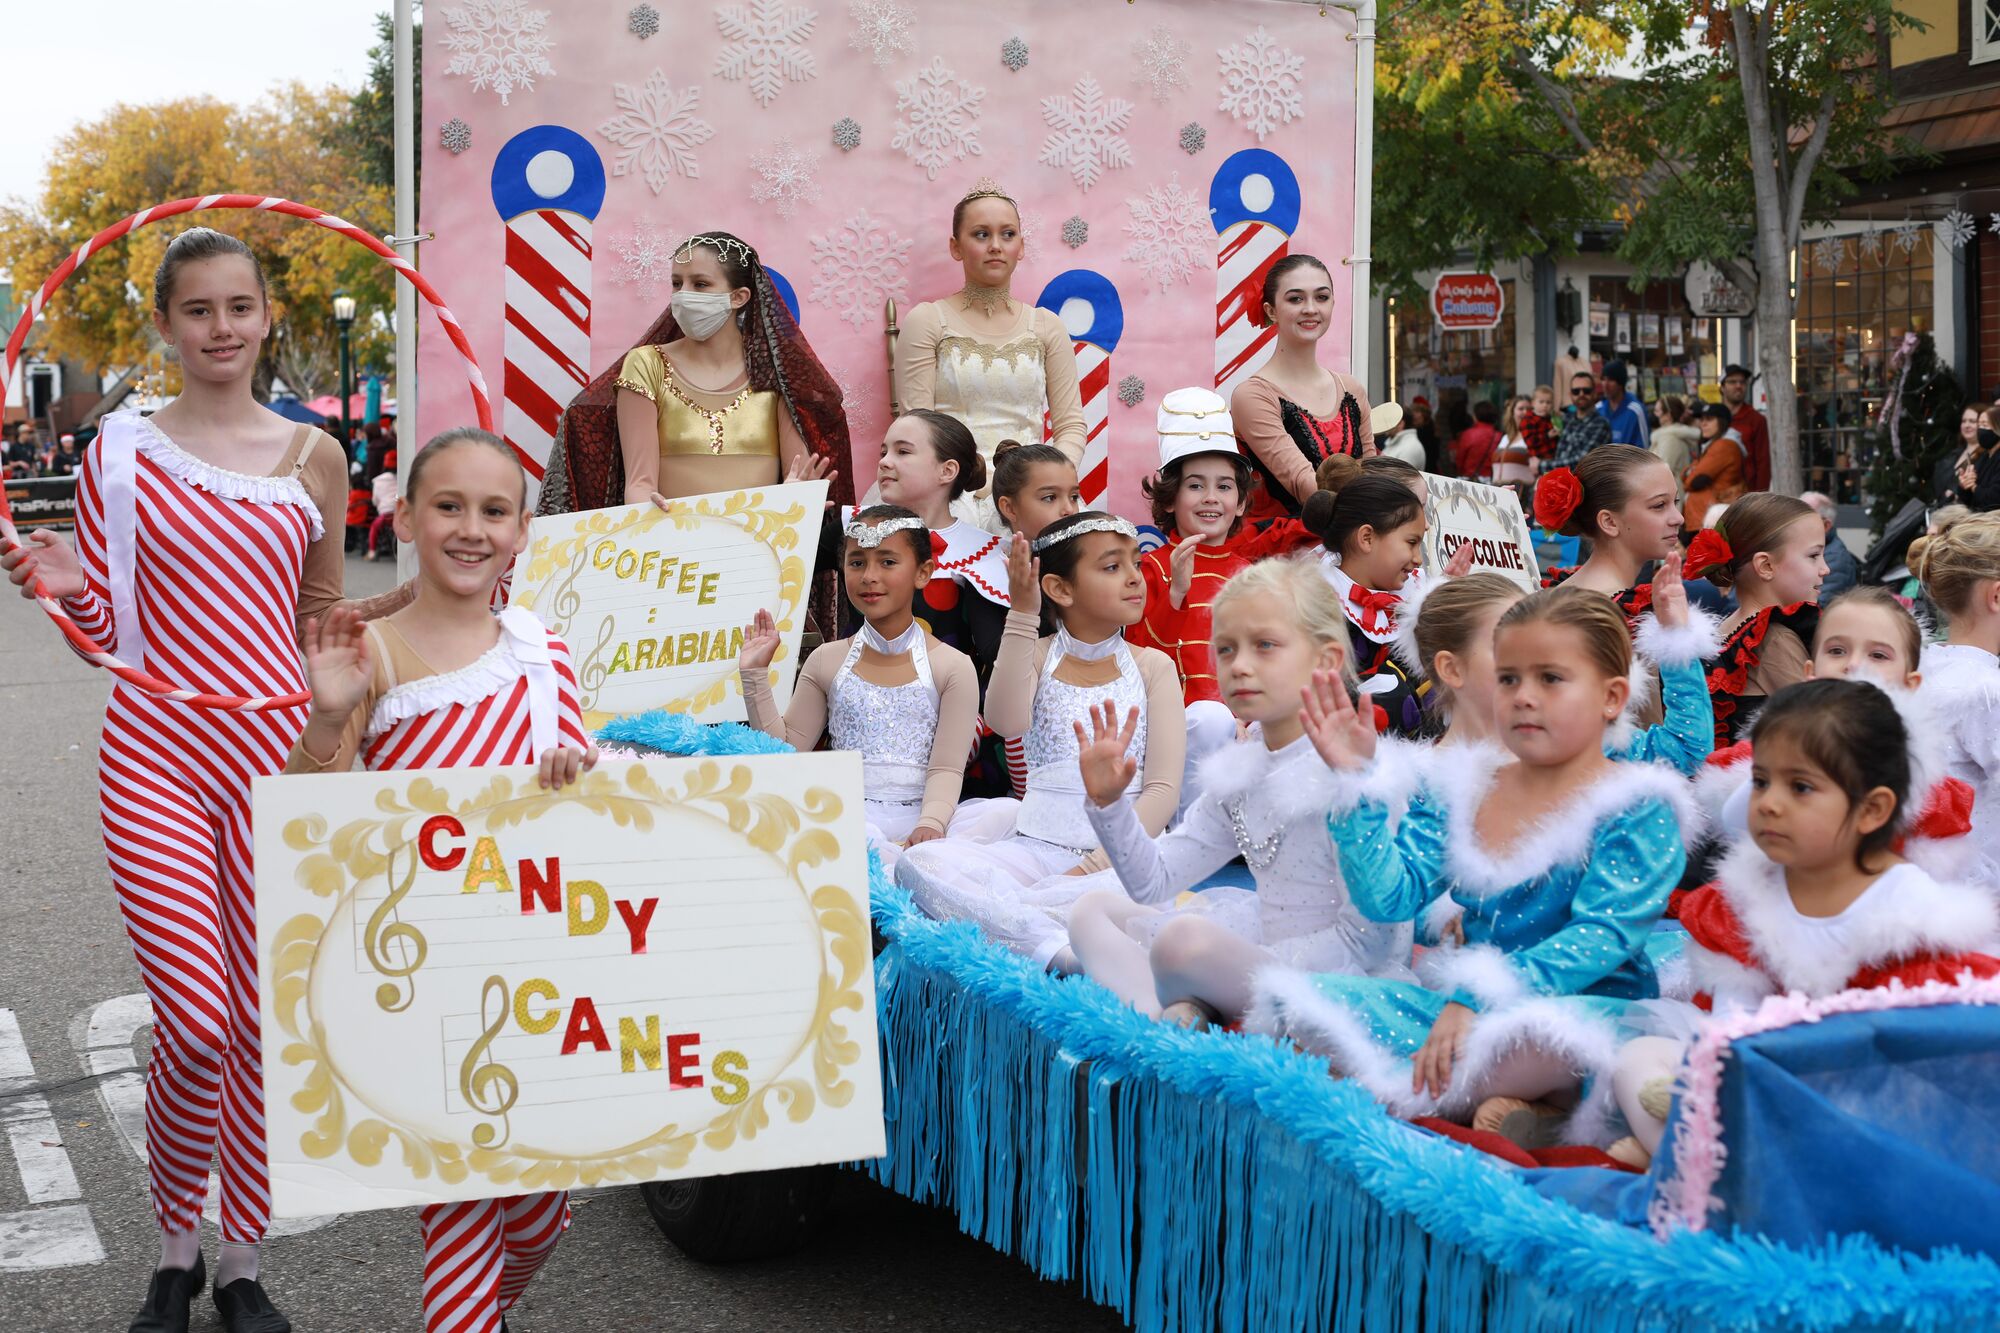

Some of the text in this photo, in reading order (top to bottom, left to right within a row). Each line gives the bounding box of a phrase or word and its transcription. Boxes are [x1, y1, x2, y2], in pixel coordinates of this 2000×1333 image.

[1452, 284, 1472, 297] Only
[9, 498, 75, 513] haPirat
[592, 540, 720, 606] COFFEE
[607, 626, 745, 675] ARABIAN
[417, 814, 659, 955] CANDY
[513, 977, 750, 1106] CANES
